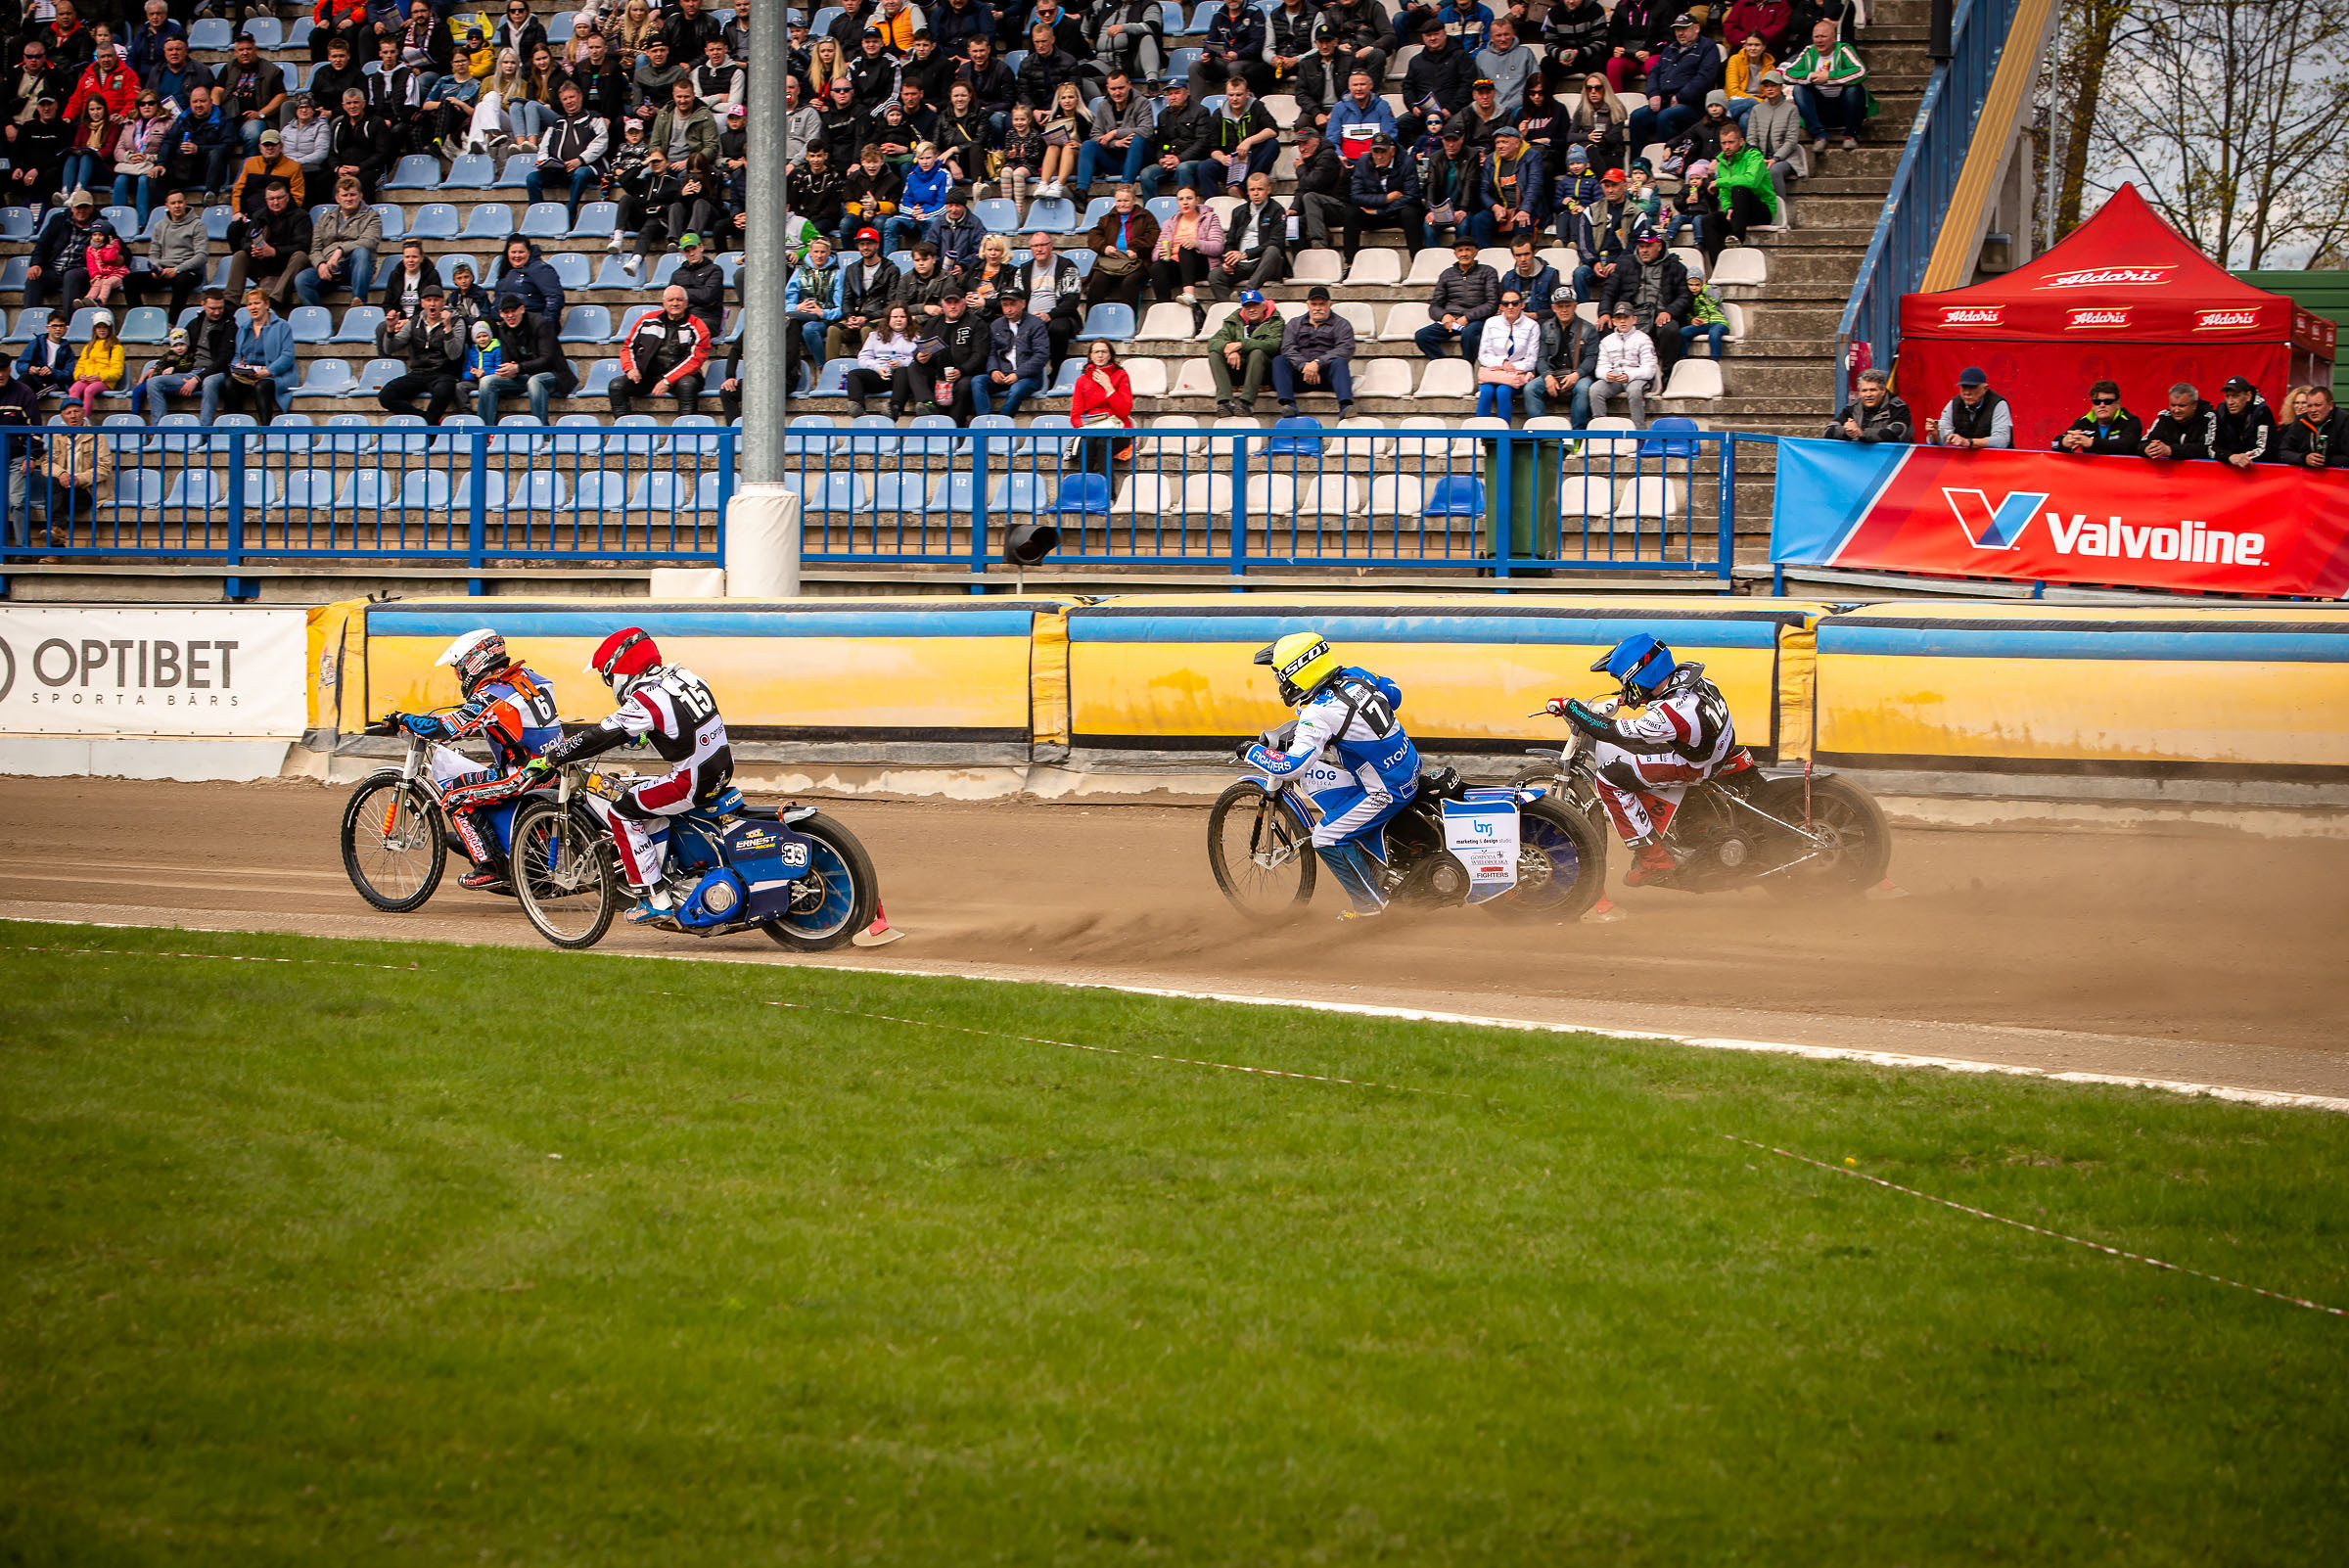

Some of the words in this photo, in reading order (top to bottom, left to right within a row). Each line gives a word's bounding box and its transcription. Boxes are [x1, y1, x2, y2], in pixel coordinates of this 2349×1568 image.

[539, 205, 553, 213] 22
[1074, 252, 1087, 260] 12
[2049, 270, 2159, 286] Aldaris
[1945, 309, 1999, 323] Aldaris
[2071, 311, 2126, 325] Aldaris
[2199, 312, 2255, 326] Aldaris
[342, 417, 352, 426] 23
[191, 473, 202, 482] 25
[362, 473, 373, 482] 22
[654, 477, 664, 485] 17
[836, 477, 845, 485] 14
[955, 478, 967, 486] 12
[1015, 479, 1025, 488] 11
[2046, 512, 2266, 566] Valvoline
[33, 638, 239, 688] OPTIBET
[32, 693, 145, 706] SPORTA
[167, 693, 238, 707] BĀRS
[533, 694, 551, 720] 6
[677, 684, 714, 719] 15
[1366, 700, 1390, 728] 7
[1705, 698, 1727, 729] 14
[1253, 750, 1292, 772] FIGHTERS
[735, 835, 777, 849] ERNEST
[782, 843, 807, 867] 33
